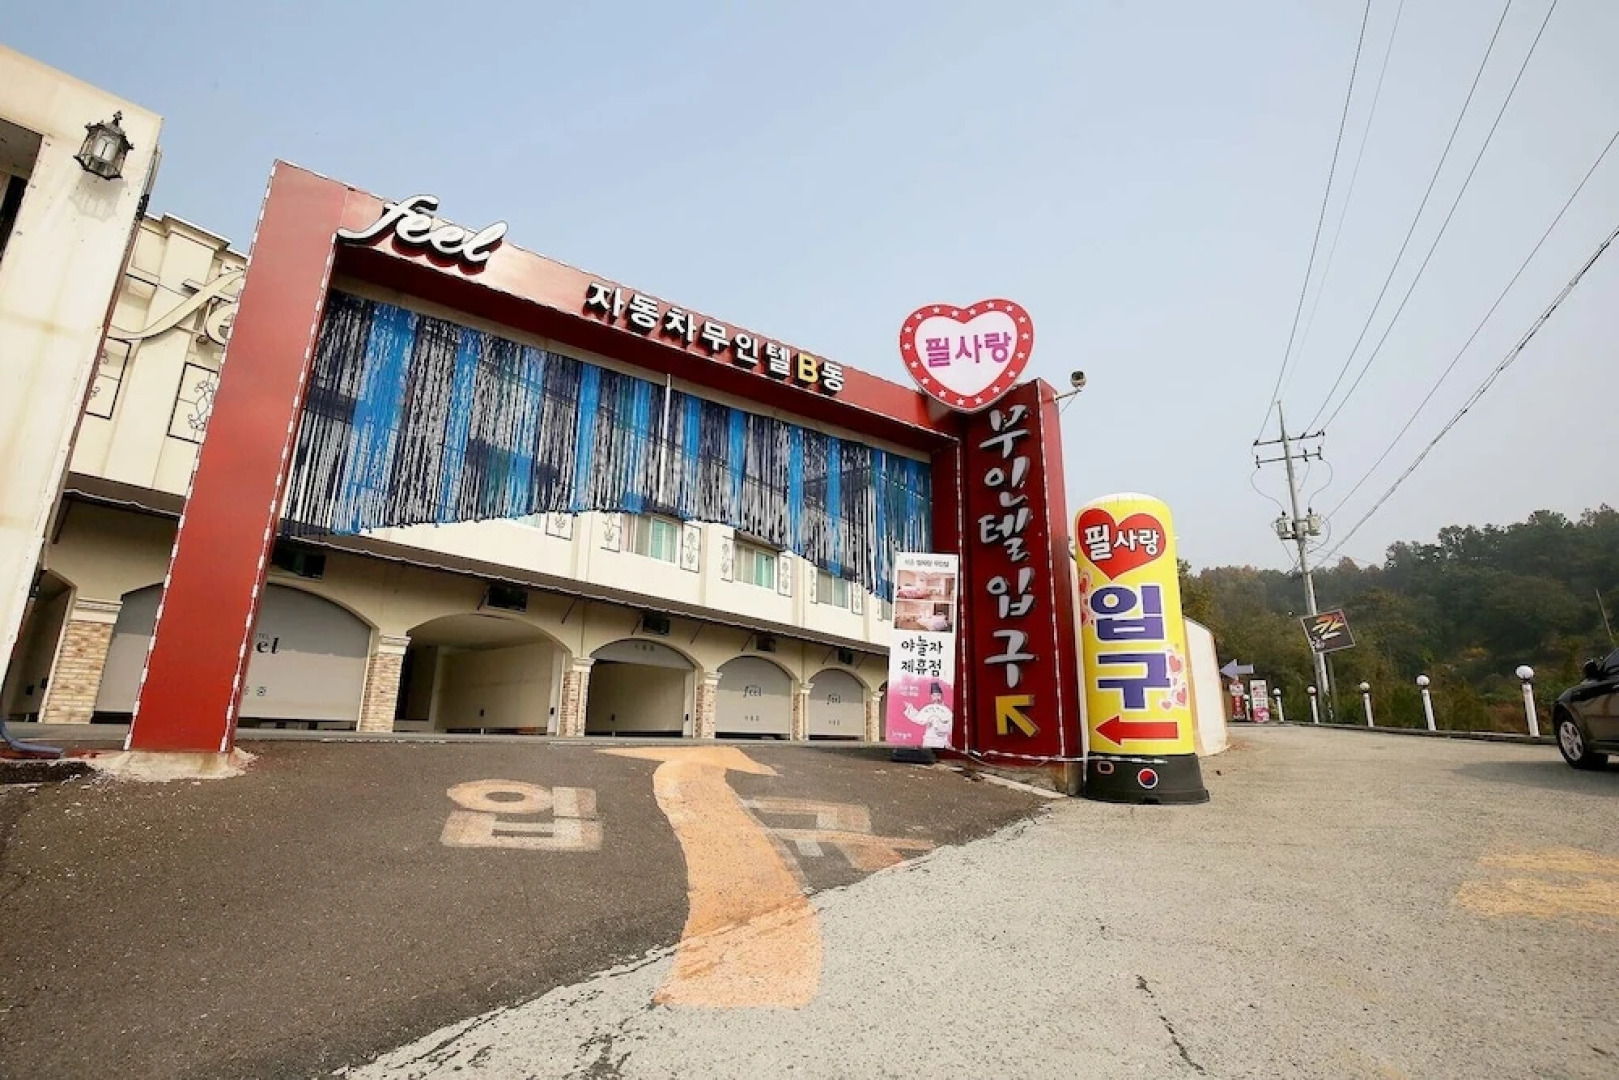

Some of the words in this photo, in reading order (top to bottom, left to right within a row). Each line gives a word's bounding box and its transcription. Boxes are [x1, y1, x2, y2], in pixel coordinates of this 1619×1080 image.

[338, 194, 508, 266] feel
[925, 331, 1012, 368] 필사랑
[1084, 524, 1160, 561] 필사랑
[901, 635, 943, 656] 야놀자
[1090, 584, 1171, 710] 입구
[901, 659, 941, 677] 제휴점
